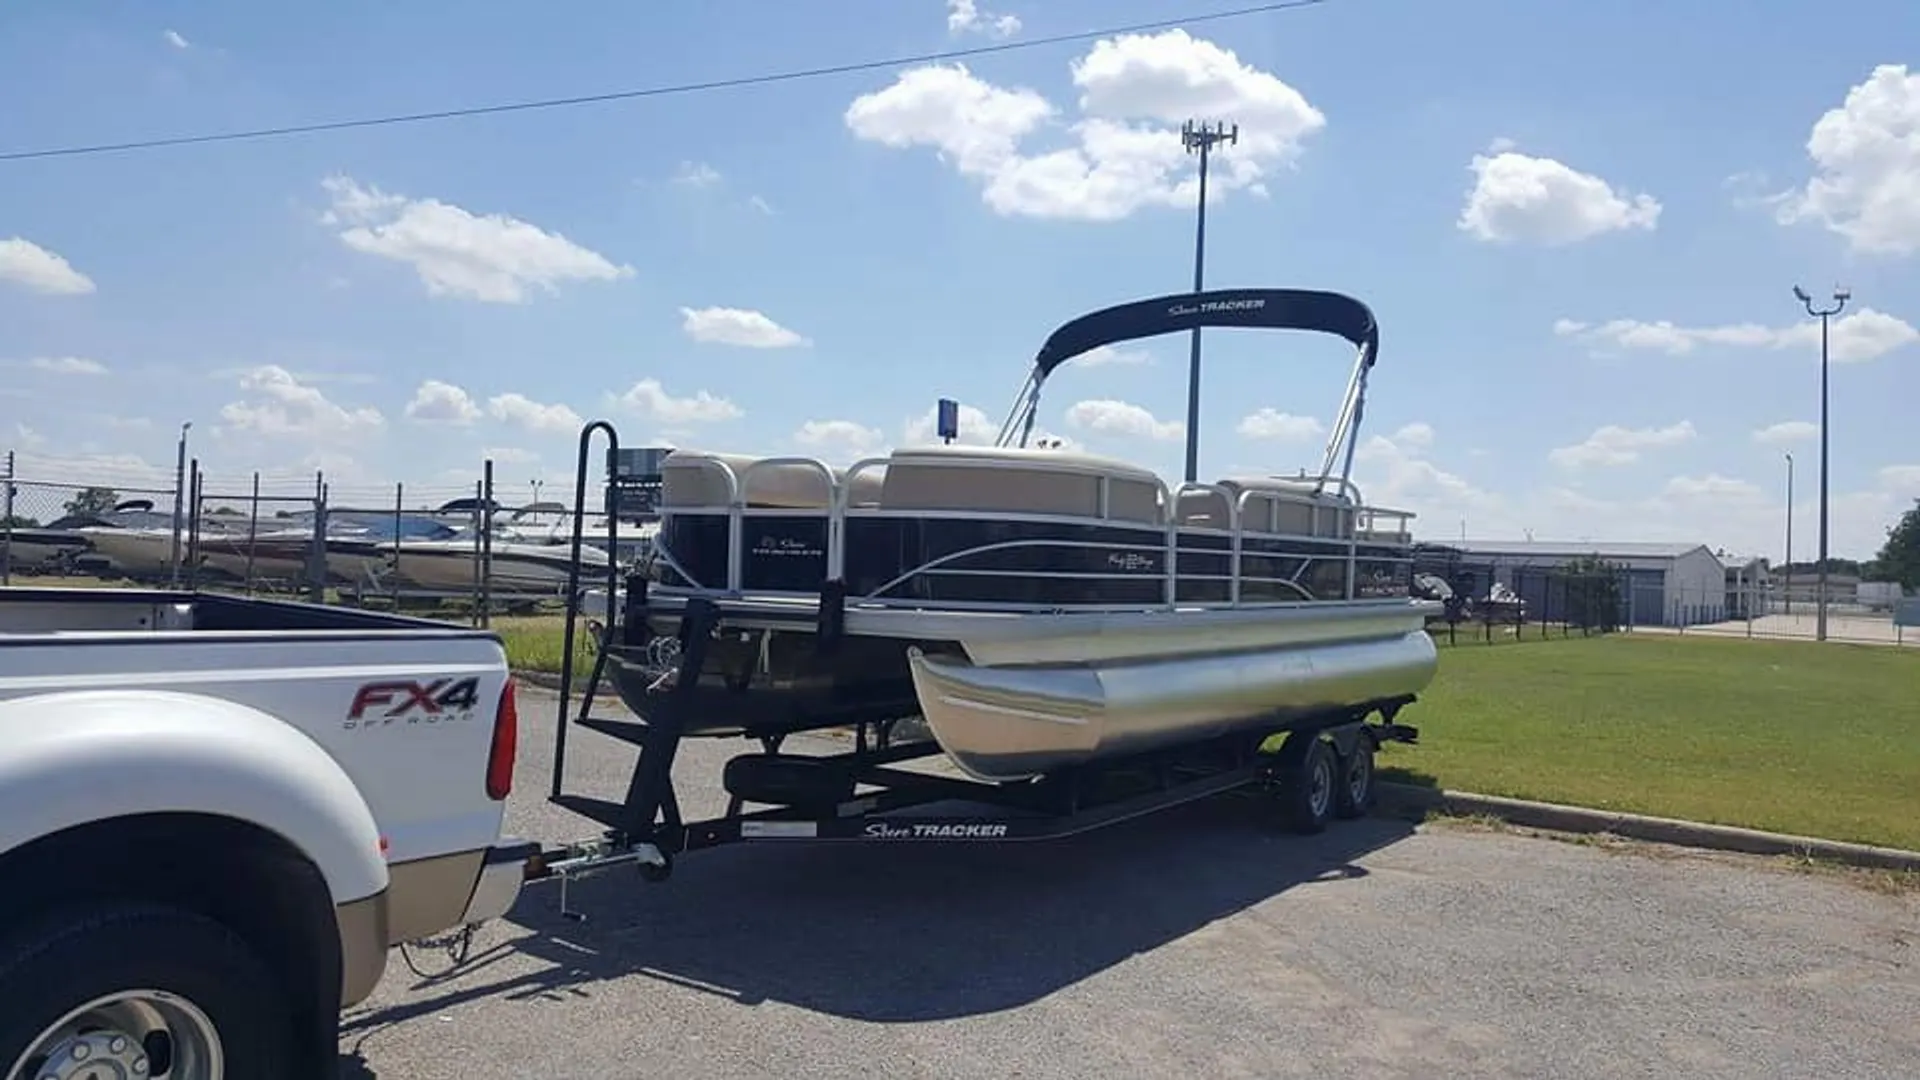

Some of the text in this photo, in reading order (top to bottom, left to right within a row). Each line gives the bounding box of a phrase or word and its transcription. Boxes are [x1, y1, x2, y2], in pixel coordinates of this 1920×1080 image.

[1201, 300, 1265, 313] TRACKER
[347, 677, 480, 718] FX4
[913, 824, 1008, 837] TRACKER
